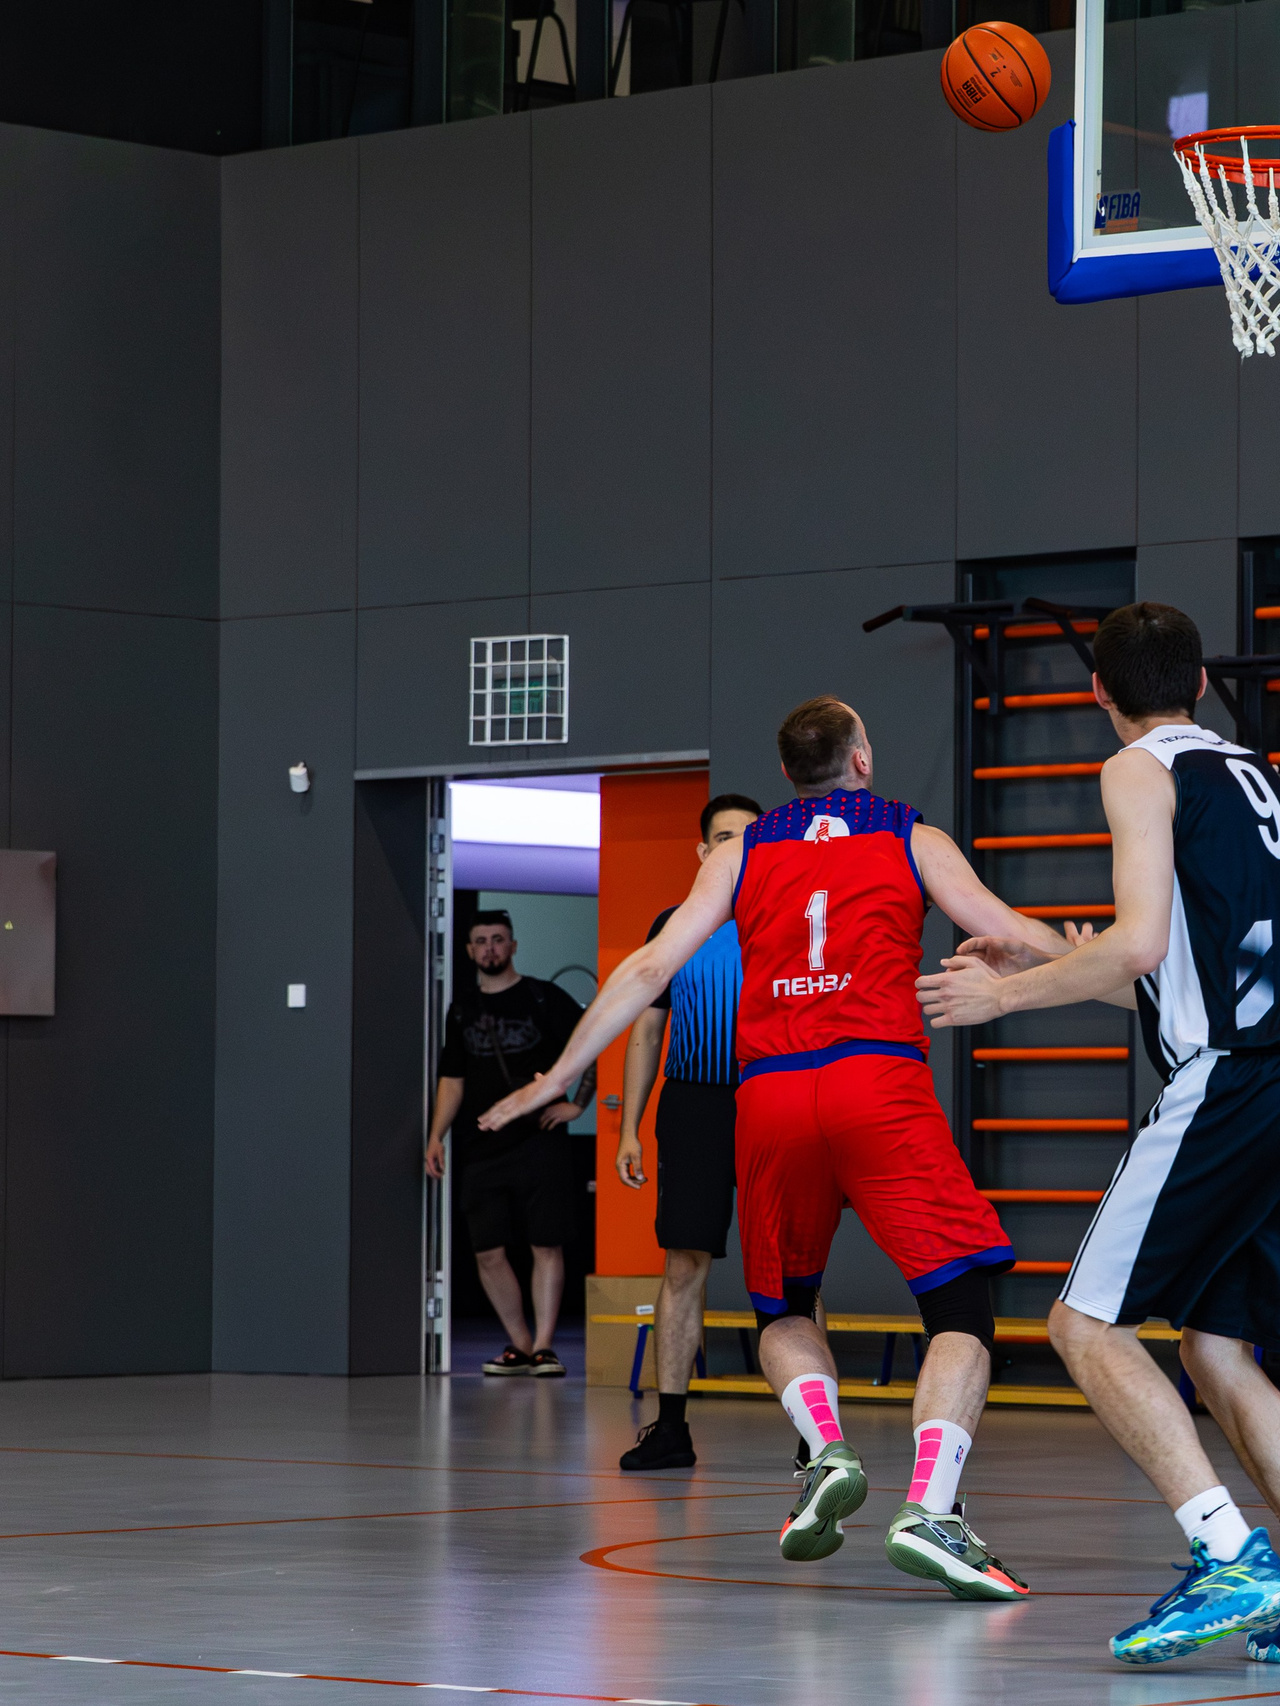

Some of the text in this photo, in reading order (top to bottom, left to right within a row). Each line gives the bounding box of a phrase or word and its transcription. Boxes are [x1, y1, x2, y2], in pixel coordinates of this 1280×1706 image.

[962, 80, 983, 104] FIBA
[1108, 192, 1141, 220] FIBA
[804, 890, 828, 971] 1
